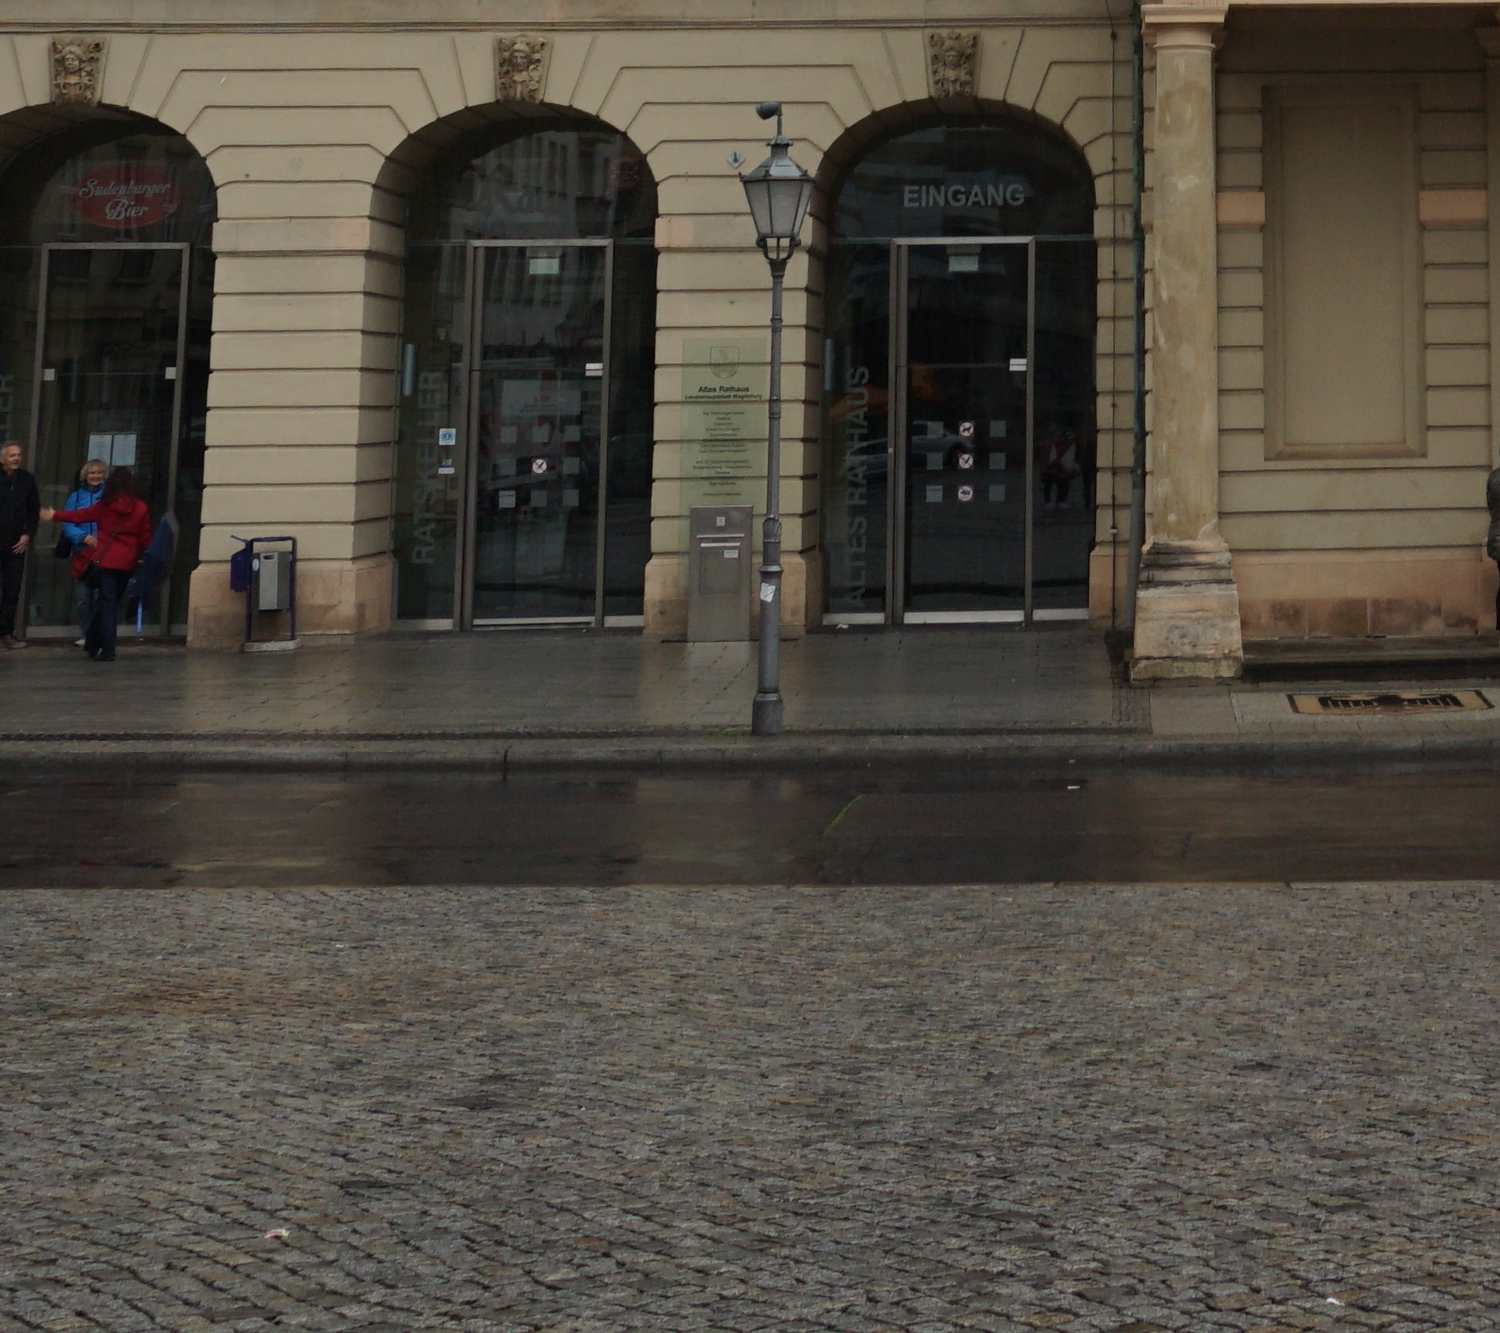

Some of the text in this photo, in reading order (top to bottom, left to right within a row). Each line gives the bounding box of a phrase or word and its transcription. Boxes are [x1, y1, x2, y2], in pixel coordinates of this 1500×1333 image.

[78, 177, 172, 198] Sudenburger
[903, 183, 1025, 208] EINGANG
[104, 197, 150, 220] Bier
[410, 370, 442, 565] RATSKELLER
[844, 365, 869, 608] ALTES RATHAUS
